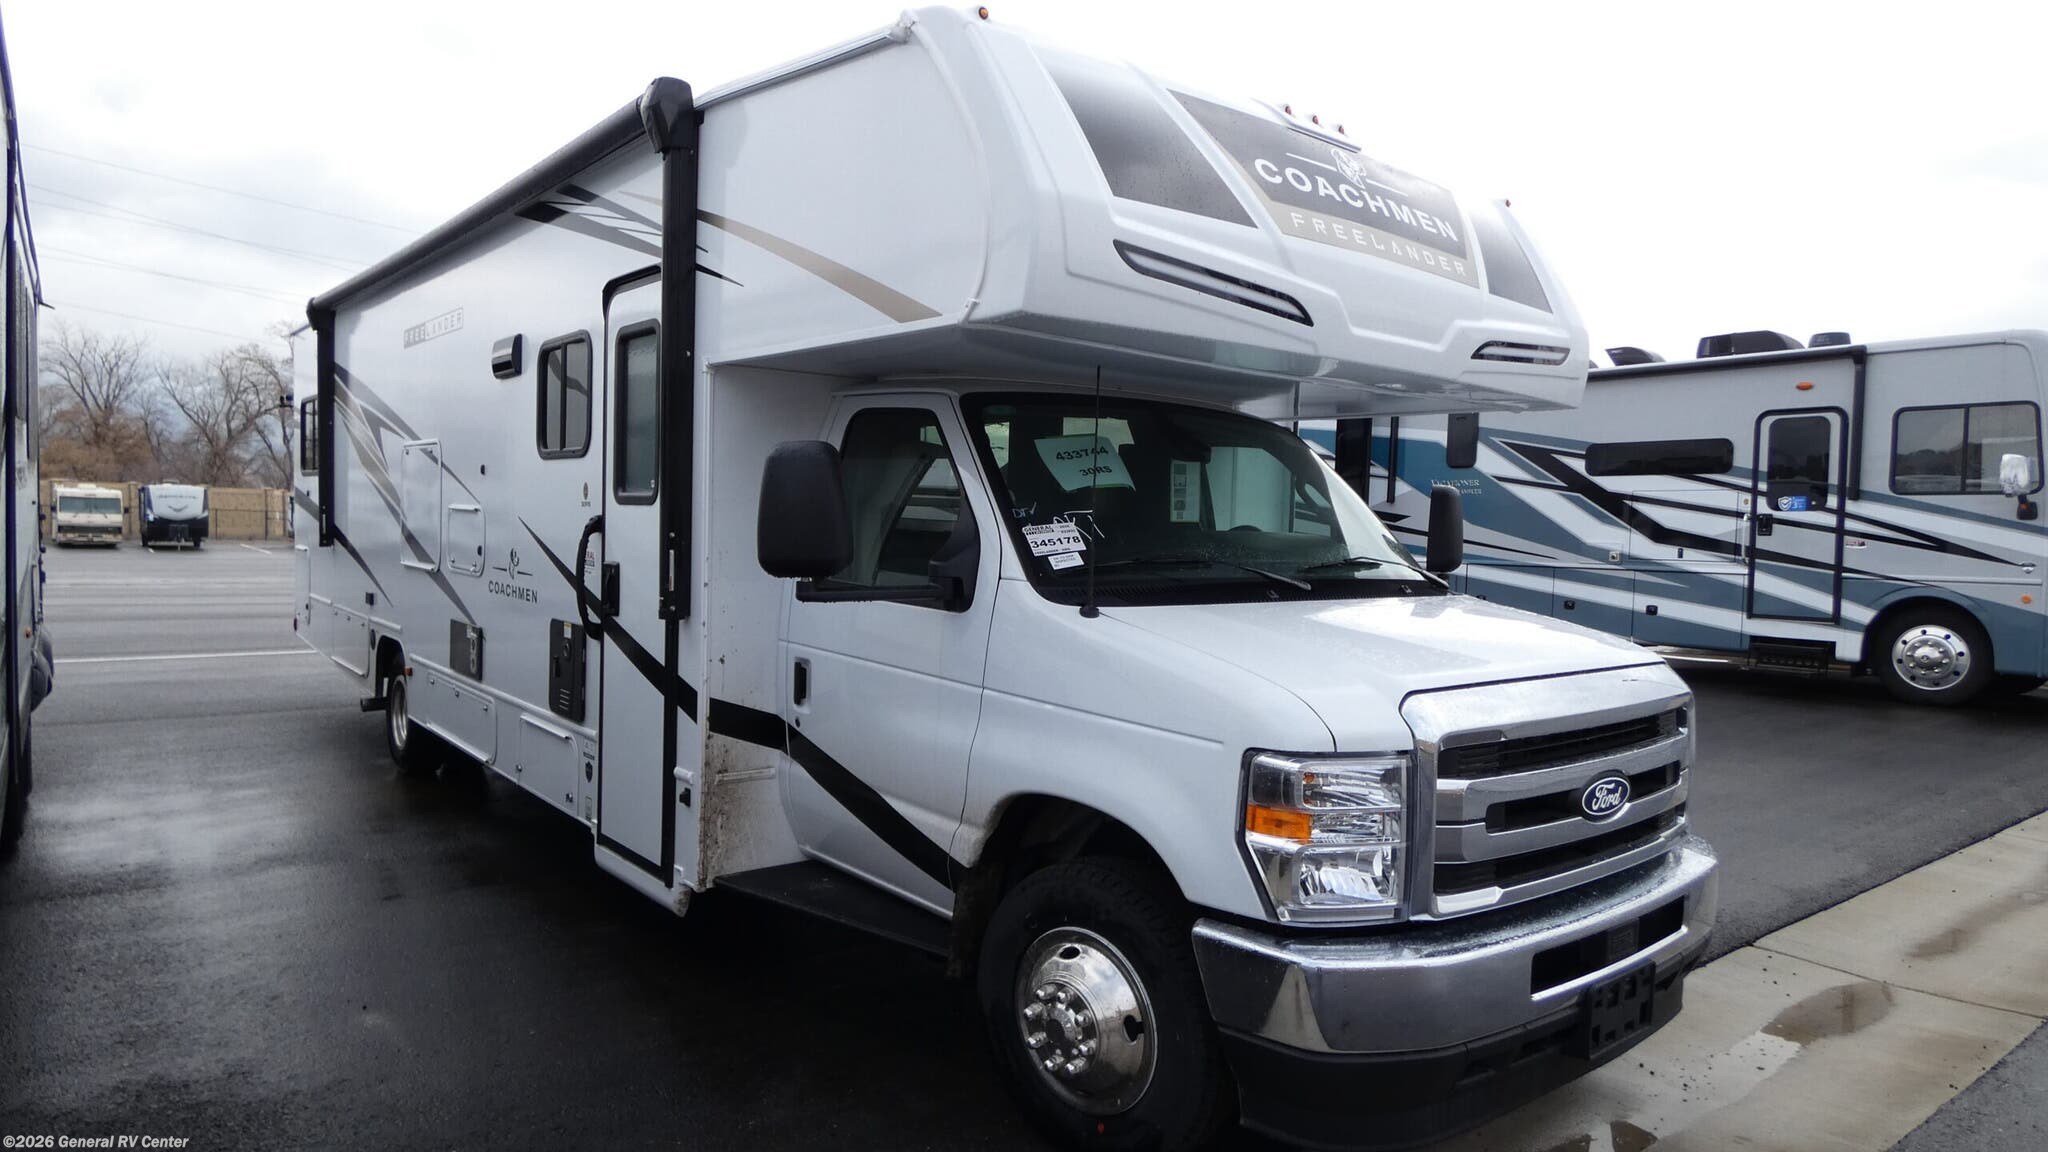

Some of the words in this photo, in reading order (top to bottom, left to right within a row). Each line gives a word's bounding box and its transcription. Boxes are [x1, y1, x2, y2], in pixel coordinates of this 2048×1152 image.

[1254, 158, 1459, 242] COACHMEN
[1291, 212, 1466, 277] FREELANDER
[1079, 465, 1113, 477] 30RS
[1030, 535, 1081, 549] 345178
[488, 580, 538, 604] COACHMEN
[1592, 783, 1622, 810] Ford
